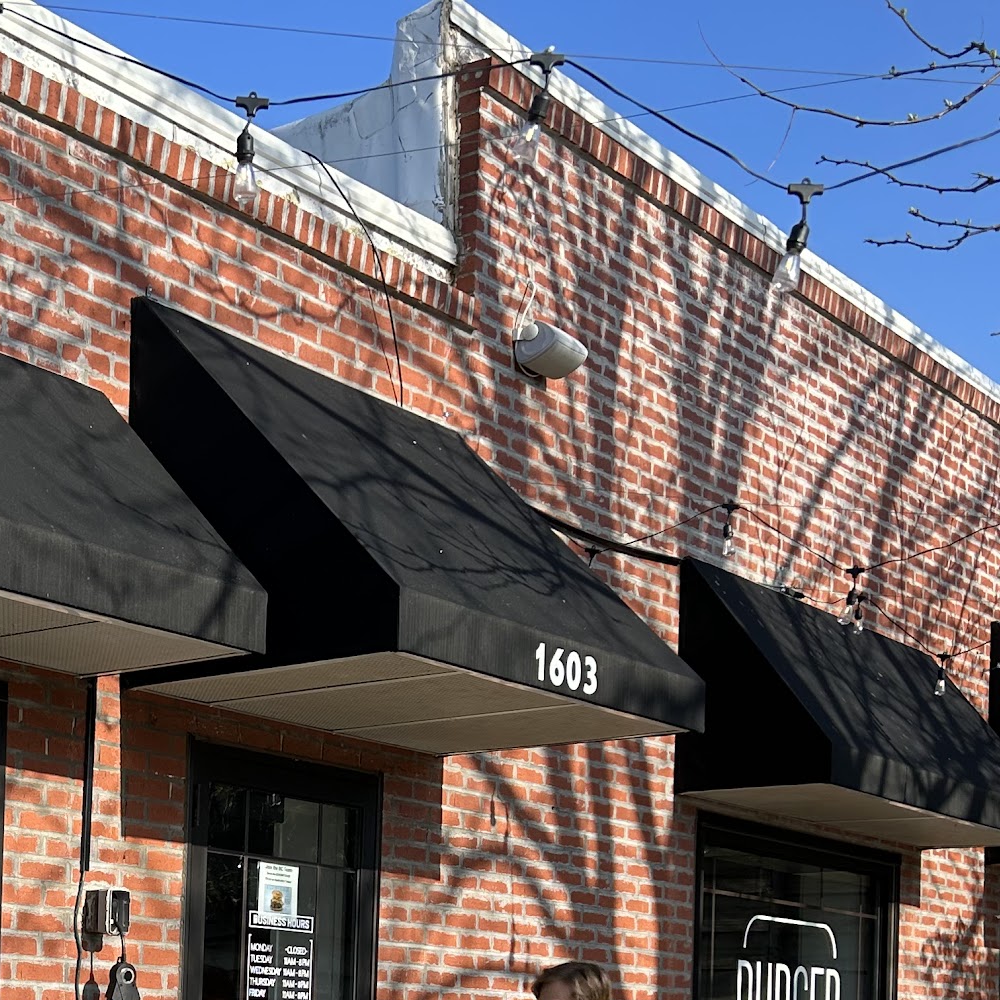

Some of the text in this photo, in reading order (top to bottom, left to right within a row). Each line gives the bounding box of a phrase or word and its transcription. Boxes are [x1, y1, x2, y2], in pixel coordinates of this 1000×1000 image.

[535, 642, 598, 695] 1603
[252, 914, 310, 930] BUSINESS HOURS
[250, 943, 273, 952] MONDAY
[250, 953, 273, 964] TUESDAY
[249, 965, 282, 976] WEDNESDAY
[249, 977, 276, 987] THURSDAY
[248, 988, 267, 998] FRIDAY
